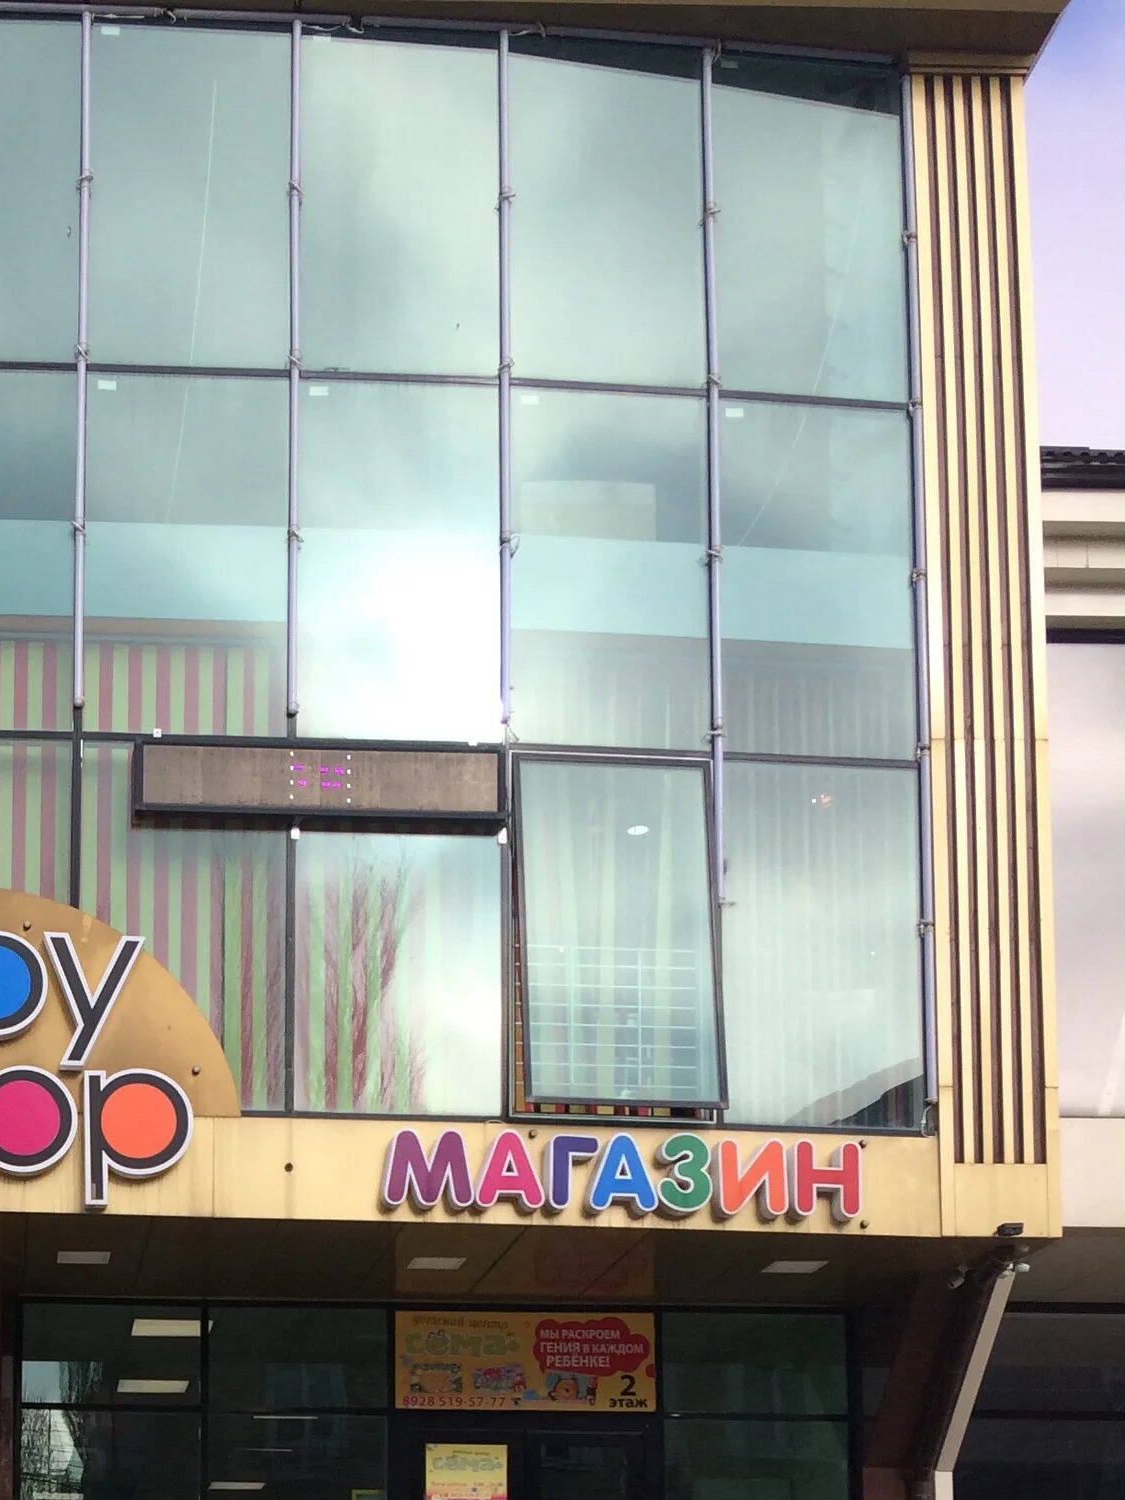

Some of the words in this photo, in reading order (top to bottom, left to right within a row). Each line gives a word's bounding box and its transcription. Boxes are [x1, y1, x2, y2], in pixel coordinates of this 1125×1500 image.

[383, 1129, 863, 1221] МАГАЗИН
[539, 1329, 559, 1339] МЫ
[561, 1329, 620, 1340] РАСКРОЕМ
[539, 1341, 581, 1353] ГЕНИЯ
[591, 1343, 644, 1356] КАЖДОМ
[619, 1374, 637, 1397] 2
[402, 1395, 435, 1407] 8928
[608, 1398, 648, 1409] этаж
